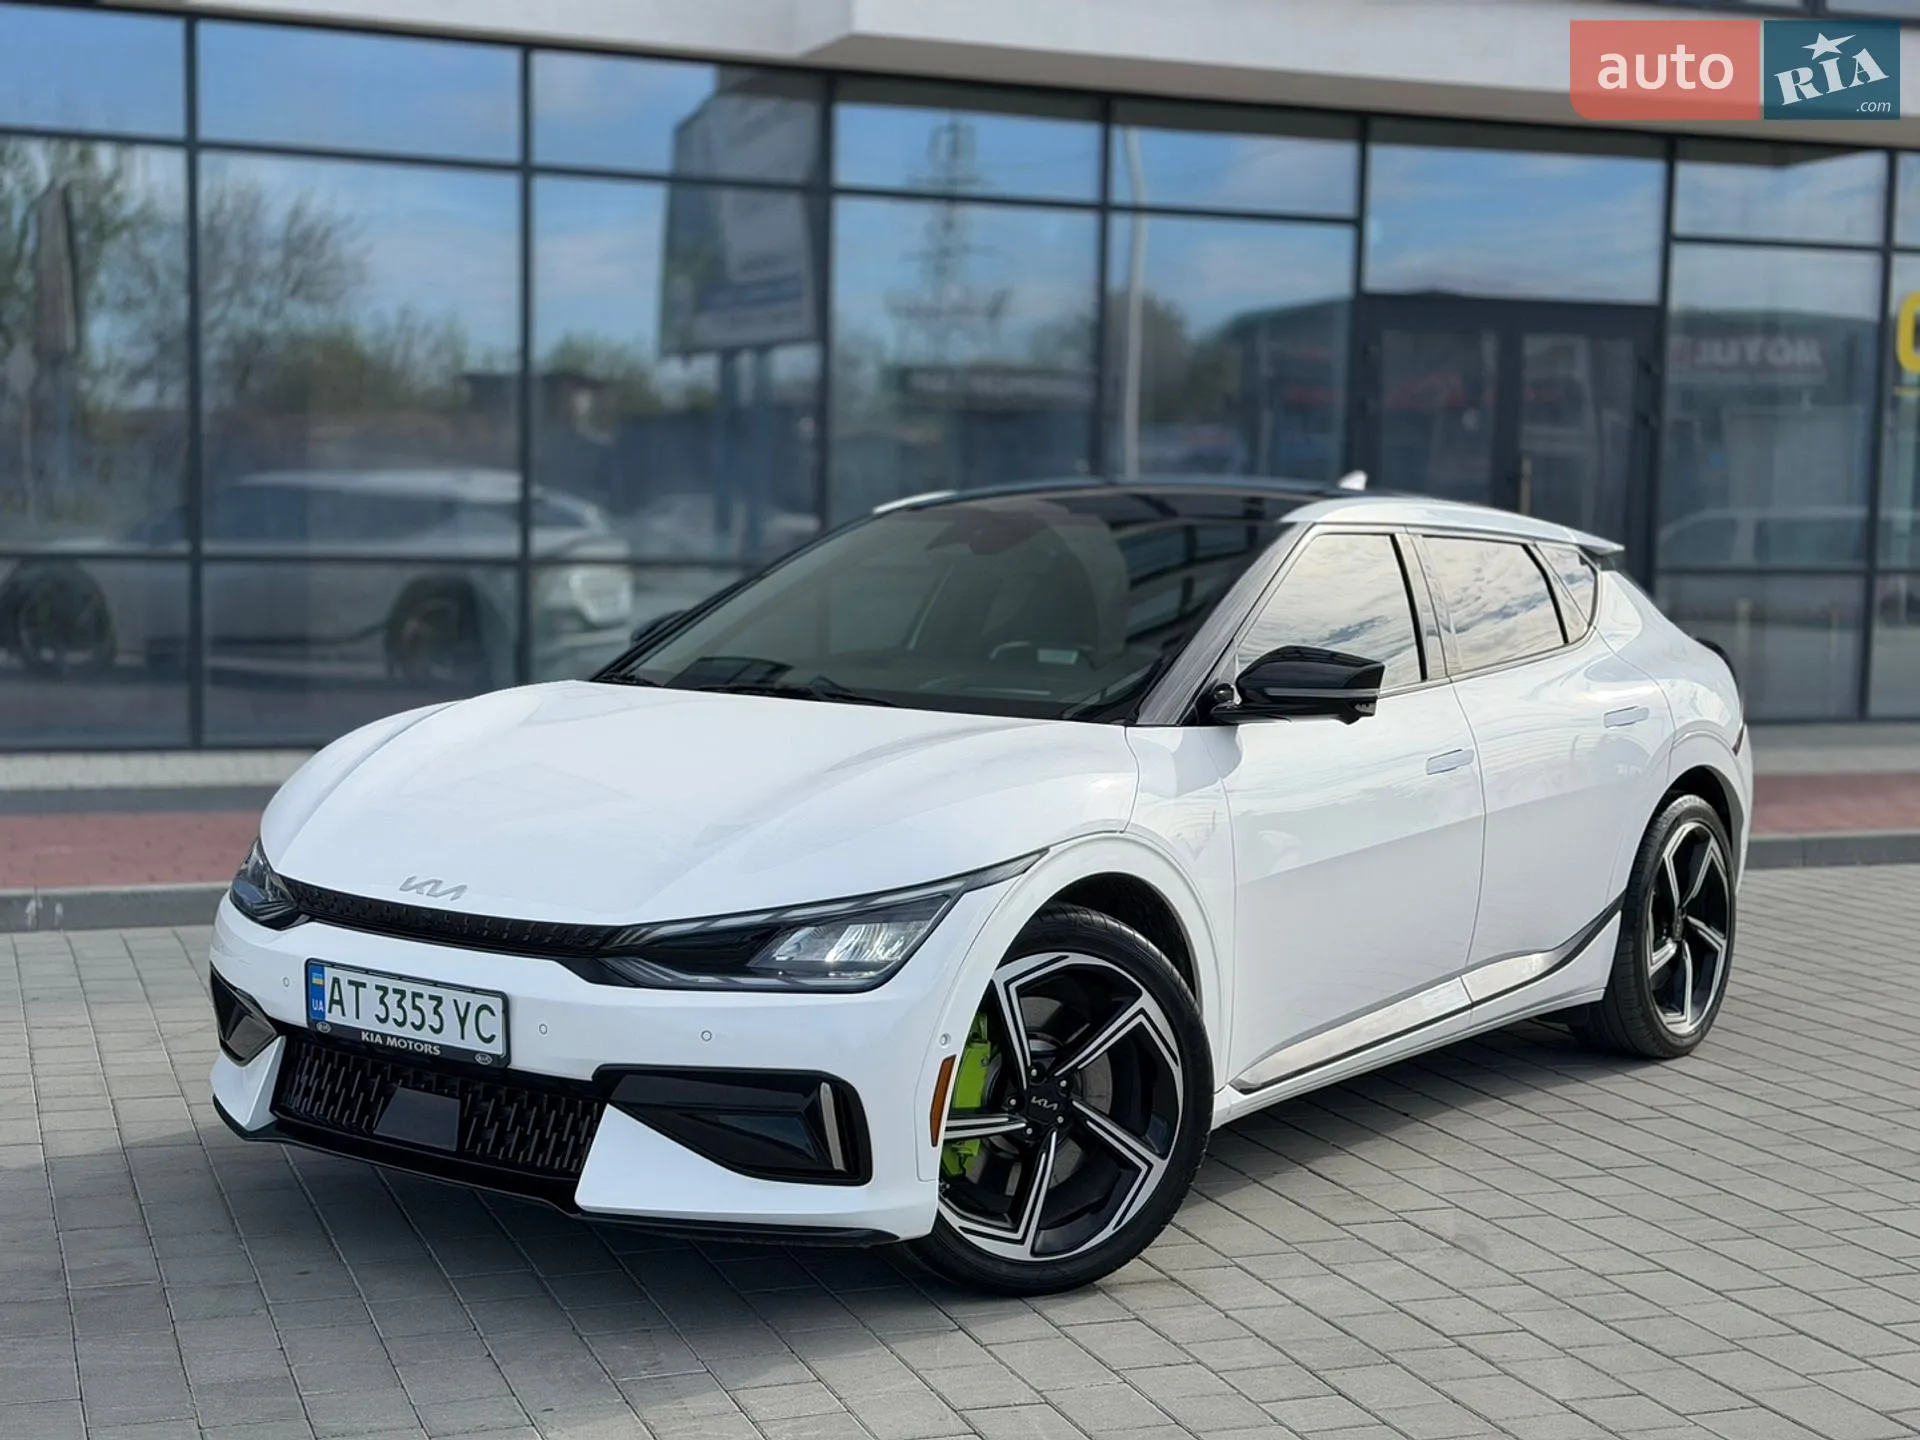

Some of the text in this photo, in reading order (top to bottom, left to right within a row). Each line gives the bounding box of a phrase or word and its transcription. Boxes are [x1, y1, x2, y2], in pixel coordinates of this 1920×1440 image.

[399, 875, 468, 901] KIA
[311, 998, 324, 1012] UA
[328, 976, 497, 1044] AT 3353 YC
[361, 1031, 441, 1056] KIA MOTORS
